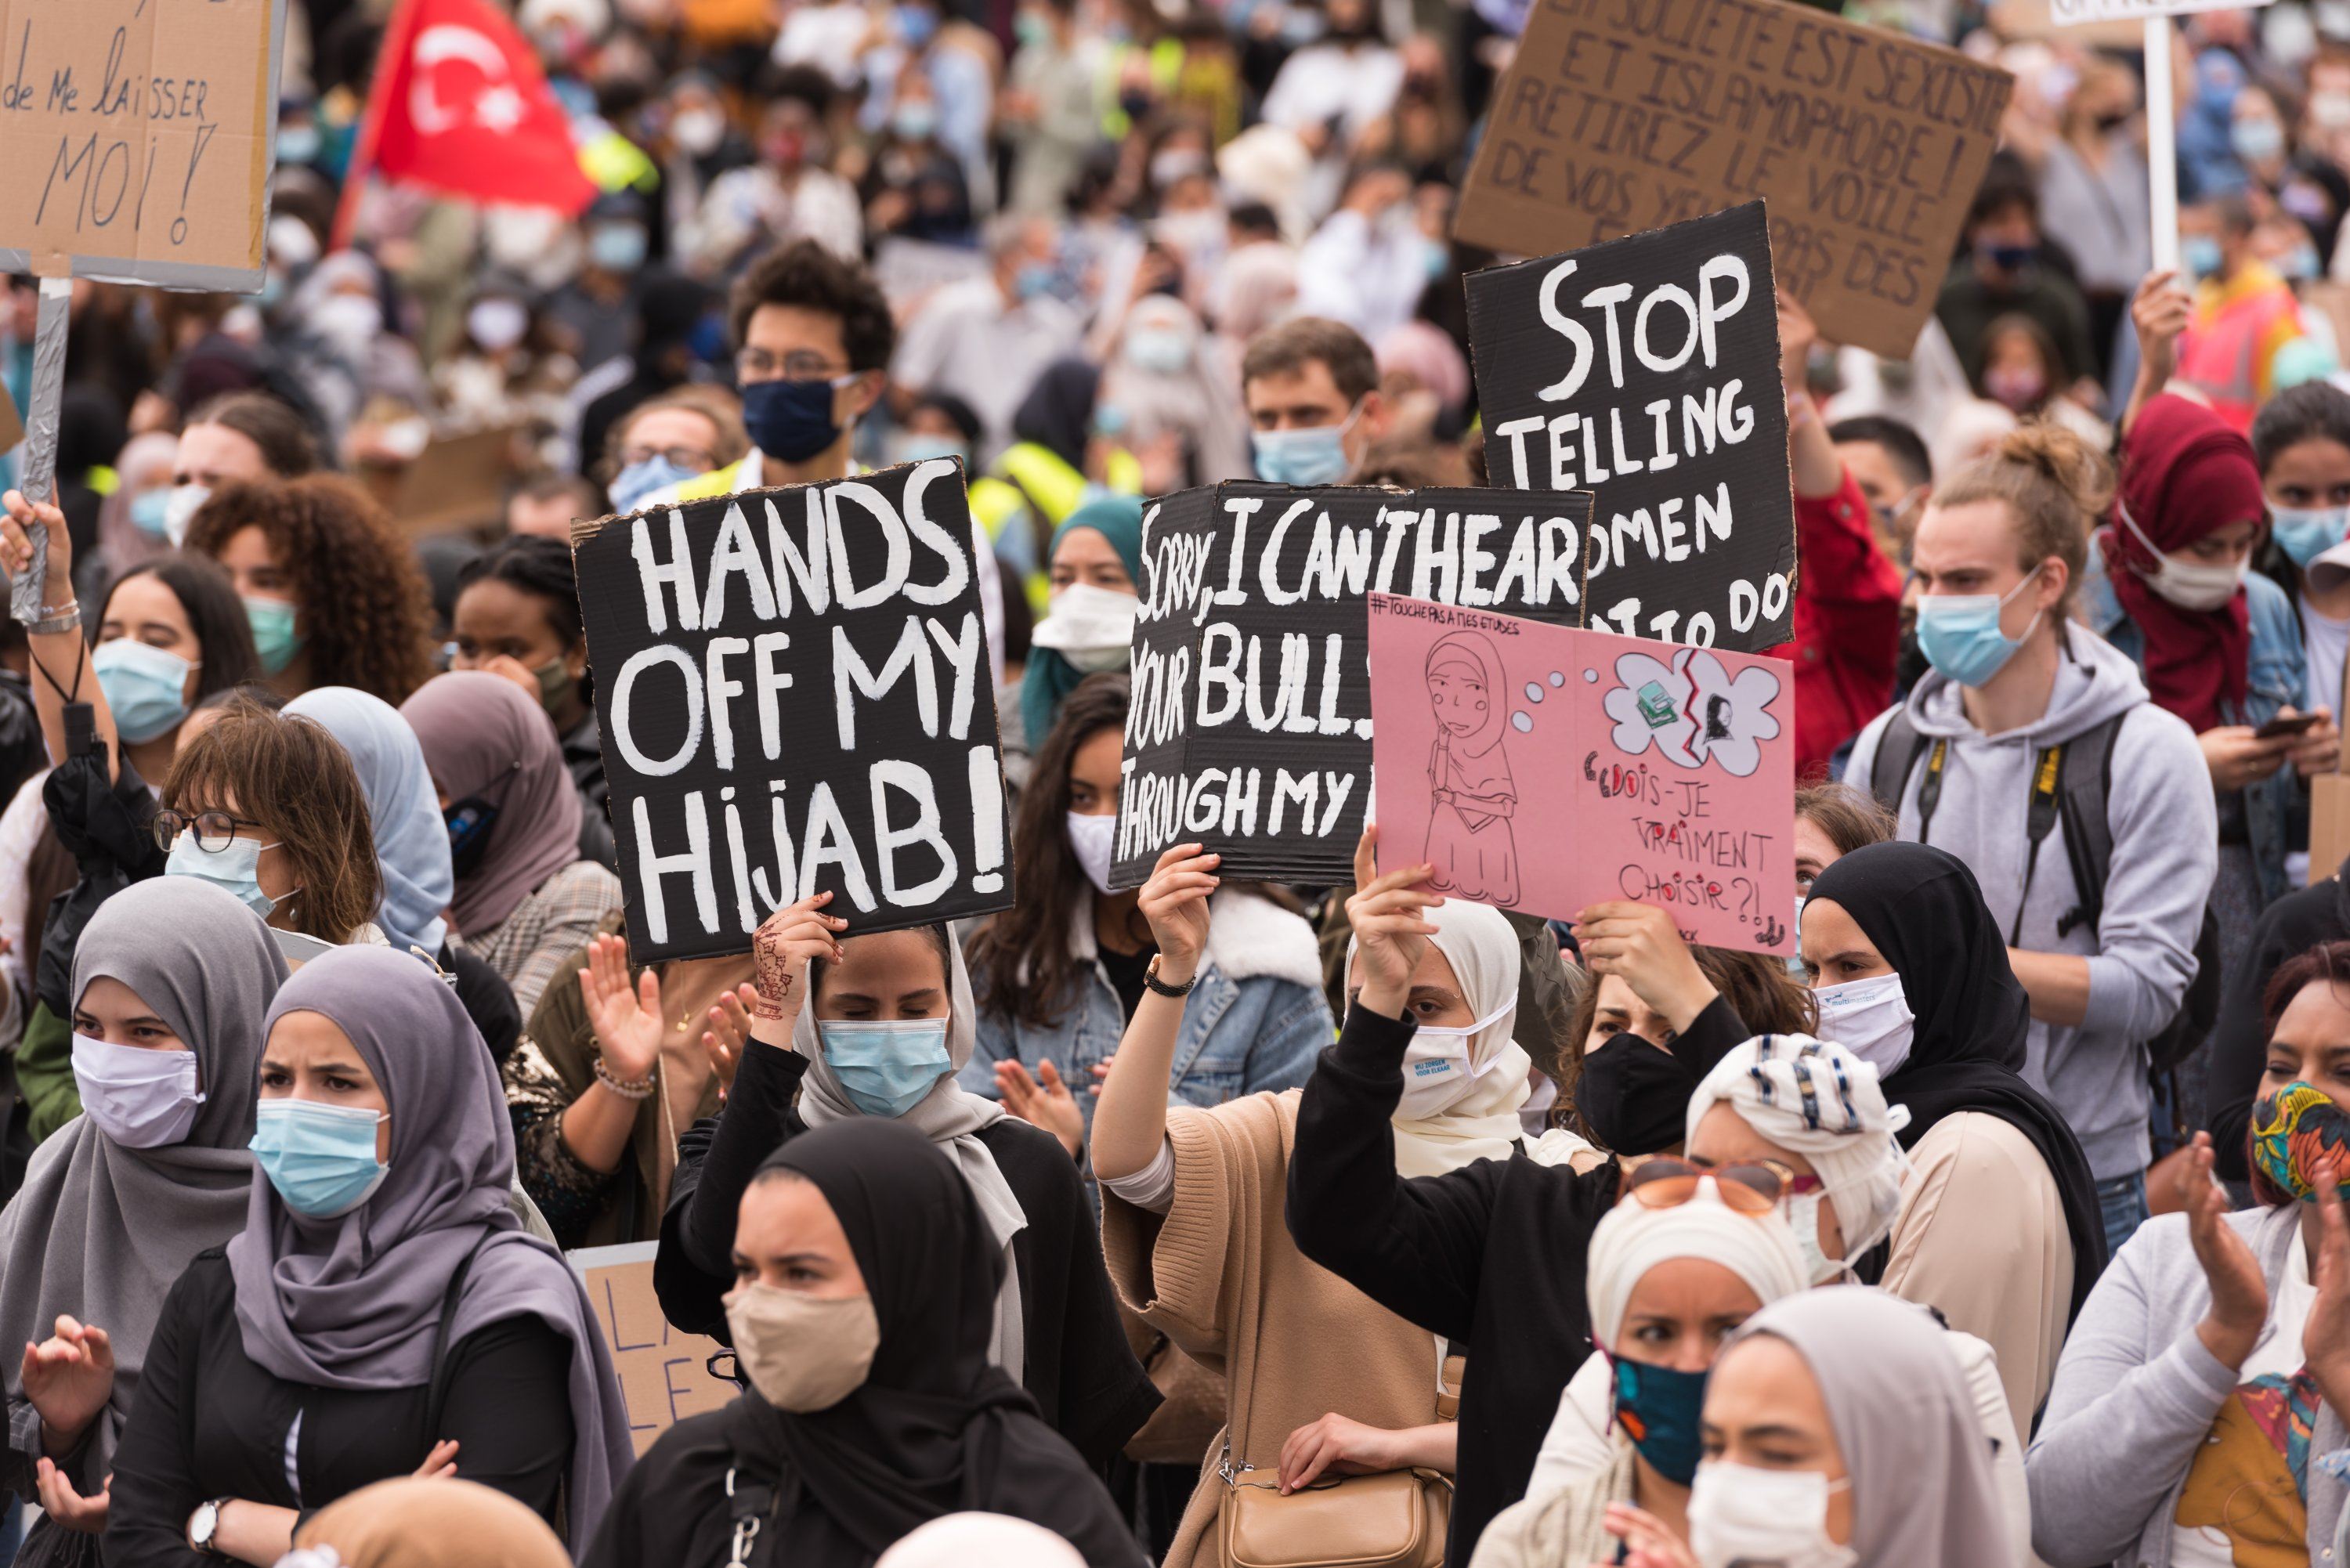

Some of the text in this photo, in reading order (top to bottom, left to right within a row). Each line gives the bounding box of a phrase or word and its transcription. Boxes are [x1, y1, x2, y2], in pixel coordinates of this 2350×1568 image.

[3, 19, 34, 111] de
[1560, 30, 1635, 90] ET
[1638, 51, 1936, 189] ISLAMOPHOBE
[1781, 21, 1869, 92] EST
[1863, 42, 2016, 139] SEXISTE
[1507, 74, 1939, 246] RETIREZ LE VOILE
[1491, 138, 1554, 197] DE
[1567, 159, 1637, 217] VOS
[1650, 182, 1723, 227] YE
[1767, 215, 1836, 280] PAS
[1842, 240, 1928, 308] DES
[1538, 255, 1750, 403] STOP
[1495, 379, 1755, 491] TELLING
[631, 459, 971, 635] HANDS
[1136, 503, 1217, 627] SORRY,
[1213, 497, 1264, 606] I
[1586, 482, 1734, 580] OMEN
[1650, 609, 1716, 650] TO
[1729, 573, 1788, 633] DO
[610, 611, 981, 777] OFF MY
[1124, 622, 1374, 751] YOUR BULL
[1117, 756, 1261, 862] THROUGH
[1267, 768, 1355, 838] MY
[1415, 1064, 1451, 1077] VOOR ELKAAR
[1425, 1058, 1445, 1068] ZORGEN
